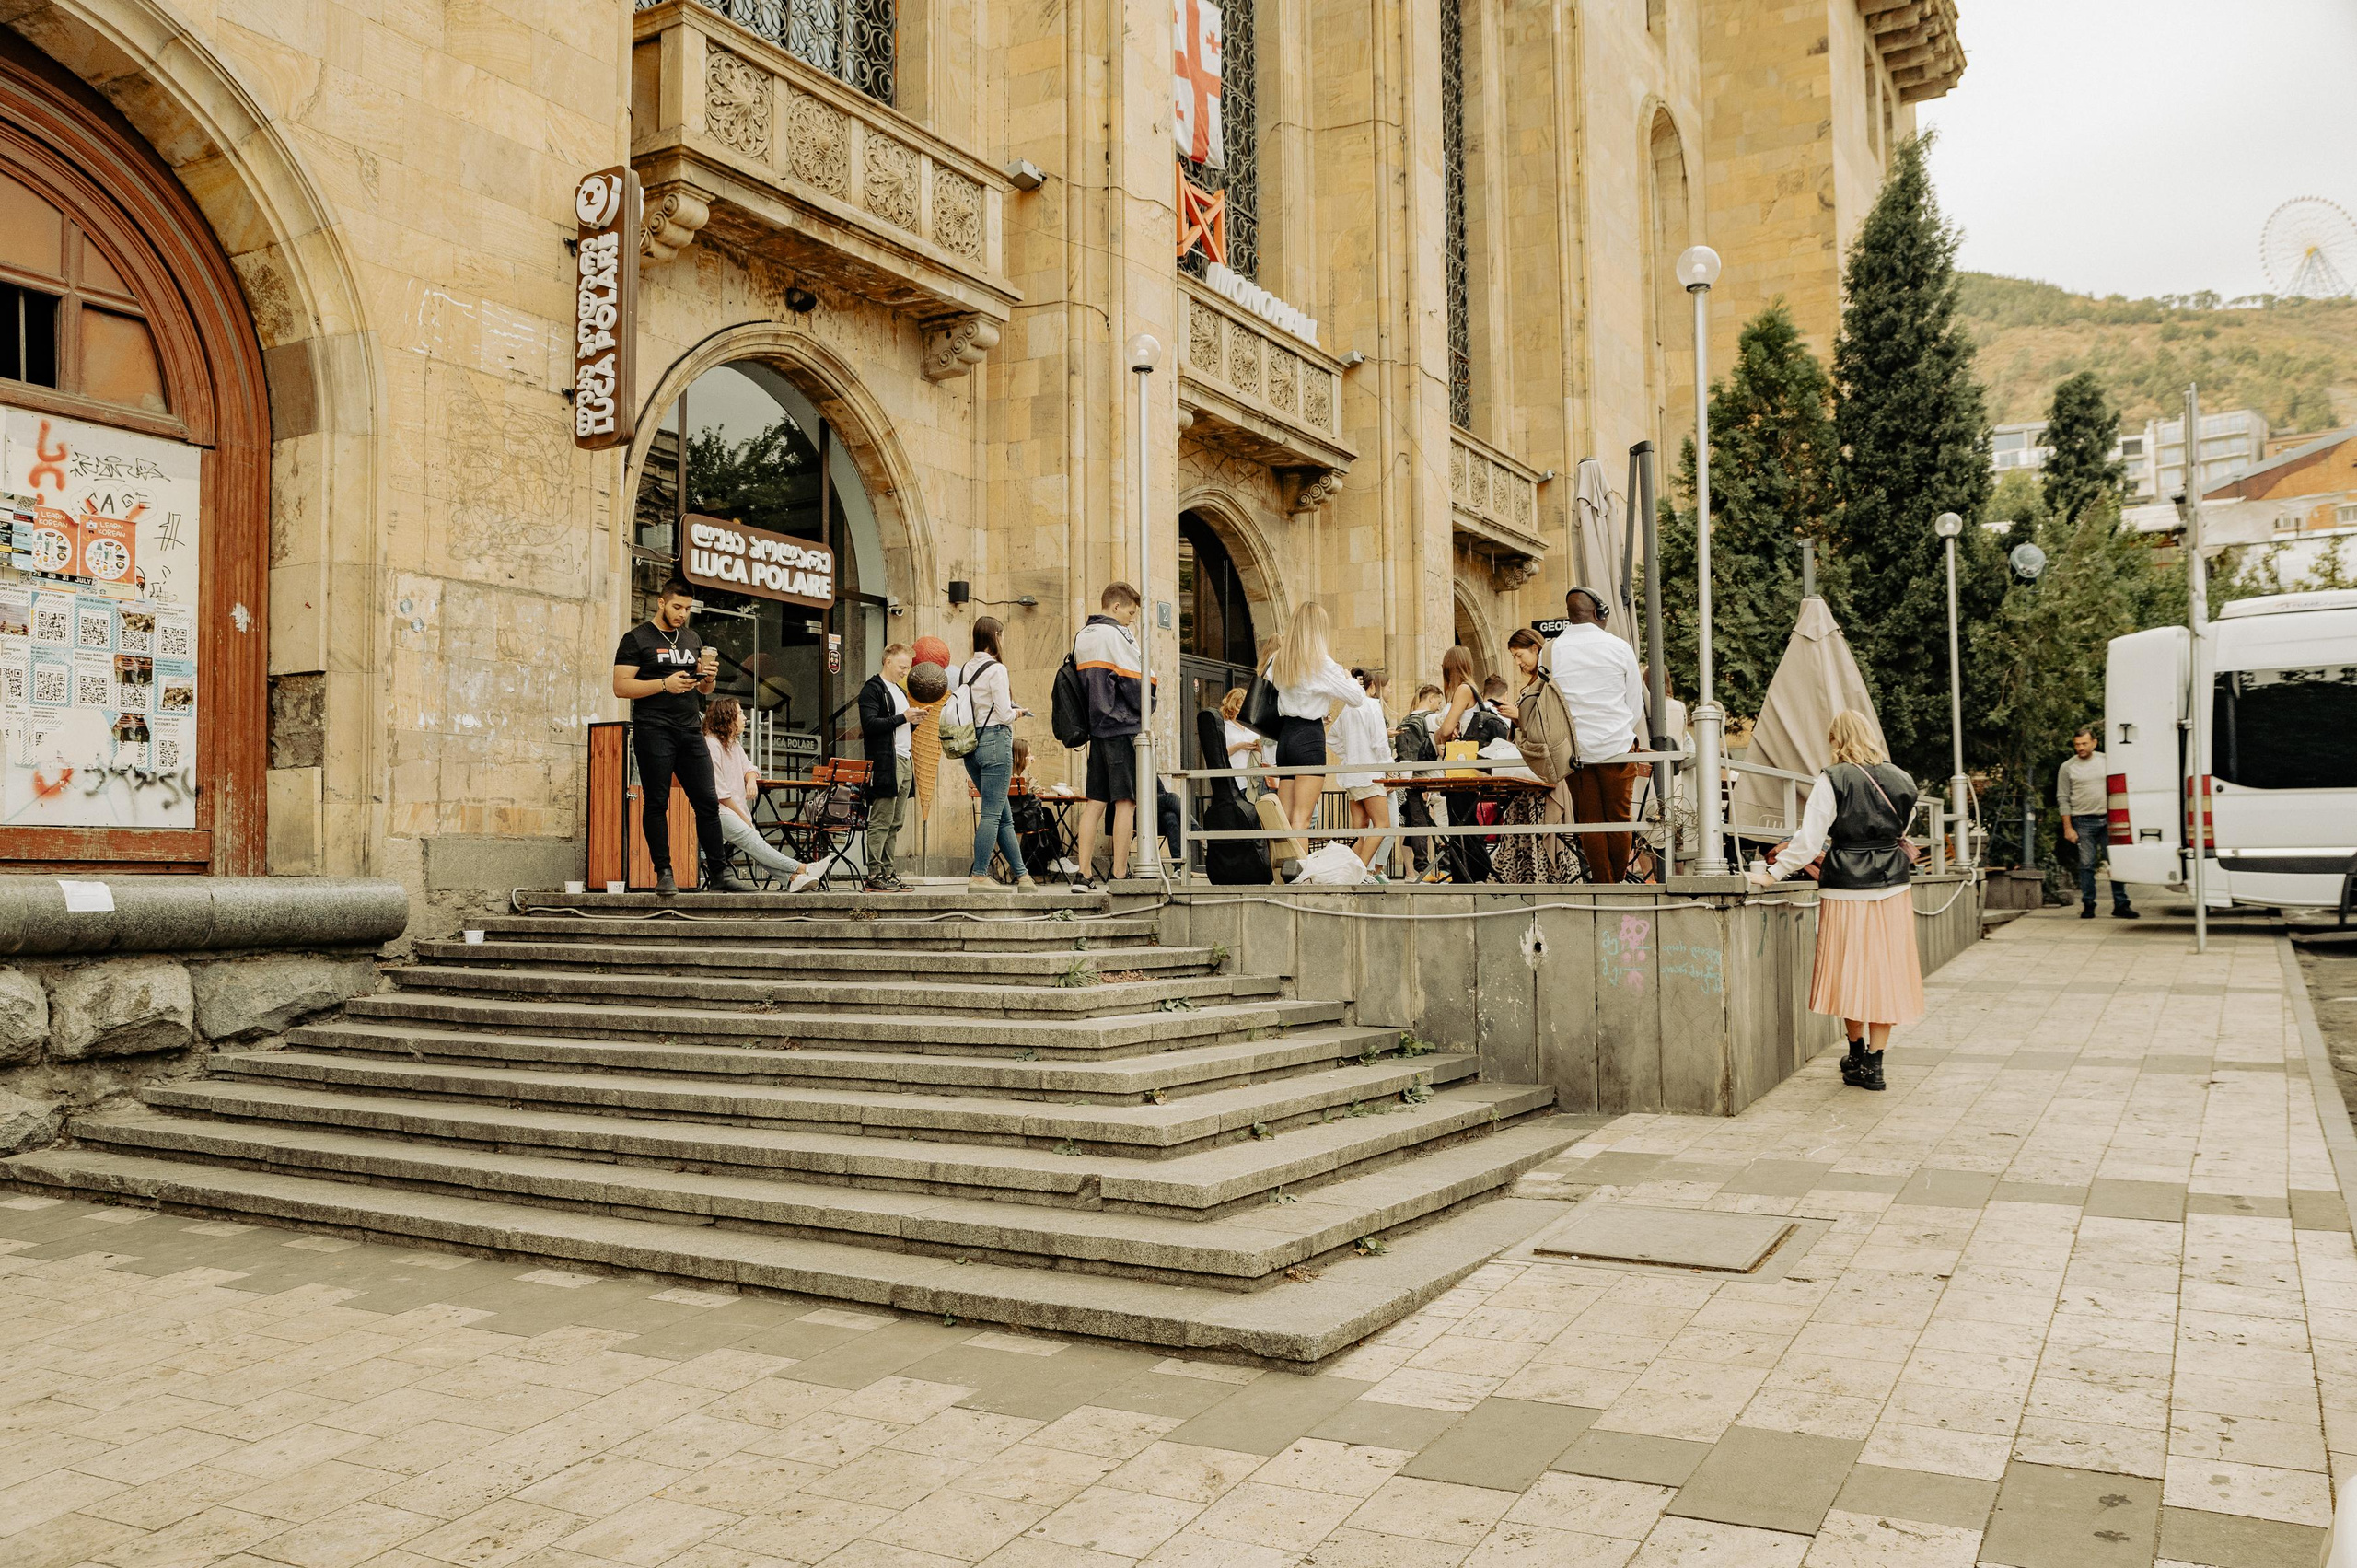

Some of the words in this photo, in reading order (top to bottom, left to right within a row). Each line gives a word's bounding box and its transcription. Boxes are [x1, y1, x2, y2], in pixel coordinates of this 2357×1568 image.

[595, 231, 619, 351] POLARE
[594, 352, 616, 435] LUCA
[41, 511, 66, 521] LEARN
[38, 518, 68, 528] KOREAN
[99, 521, 124, 530] LEARN
[98, 528, 126, 538] KOREAN
[691, 523, 746, 556] ლუკა
[748, 535, 831, 574] პოლარე
[691, 548, 749, 584] LUCA
[751, 562, 832, 600] POLARE
[75, 576, 92, 586] JULY
[1163, 608, 1169, 622] 2
[1539, 621, 1571, 632] GEOR
[656, 648, 696, 664] FILA
[787, 738, 815, 749] POLARE
